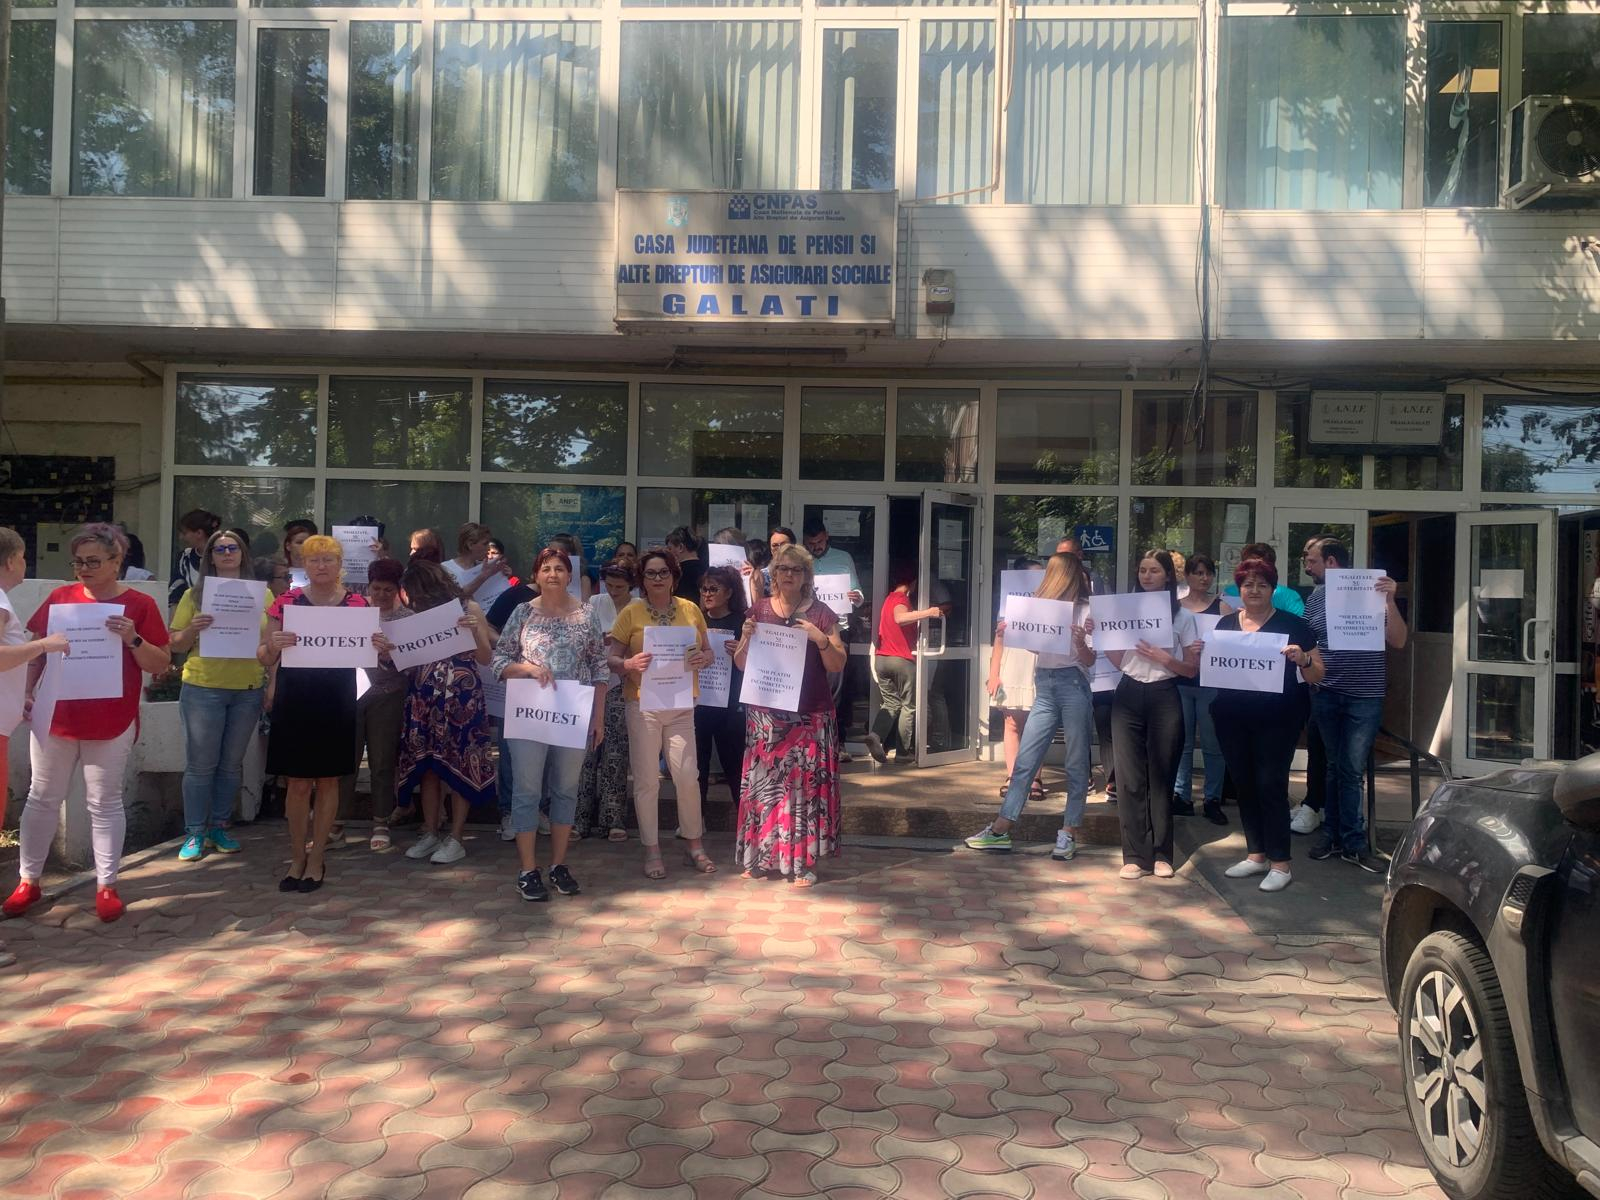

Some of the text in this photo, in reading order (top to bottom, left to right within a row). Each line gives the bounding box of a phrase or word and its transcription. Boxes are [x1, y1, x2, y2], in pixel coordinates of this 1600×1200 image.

[752, 194, 818, 209] CNPAS
[634, 234, 876, 254] CASA JUDETEANA DE PENSII SI
[618, 264, 891, 284] ALTE DREPTURI DE ASIGURARI SOCIALE
[1400, 405, 1433, 414] A.N.I.F.
[1011, 621, 1064, 635] PROTEST
[1101, 618, 1162, 632] PROTEST
[295, 635, 367, 648] PROTEST
[397, 626, 461, 653] PROTEST
[1210, 656, 1275, 671] PROTEST
[515, 707, 580, 726] PROTEST
